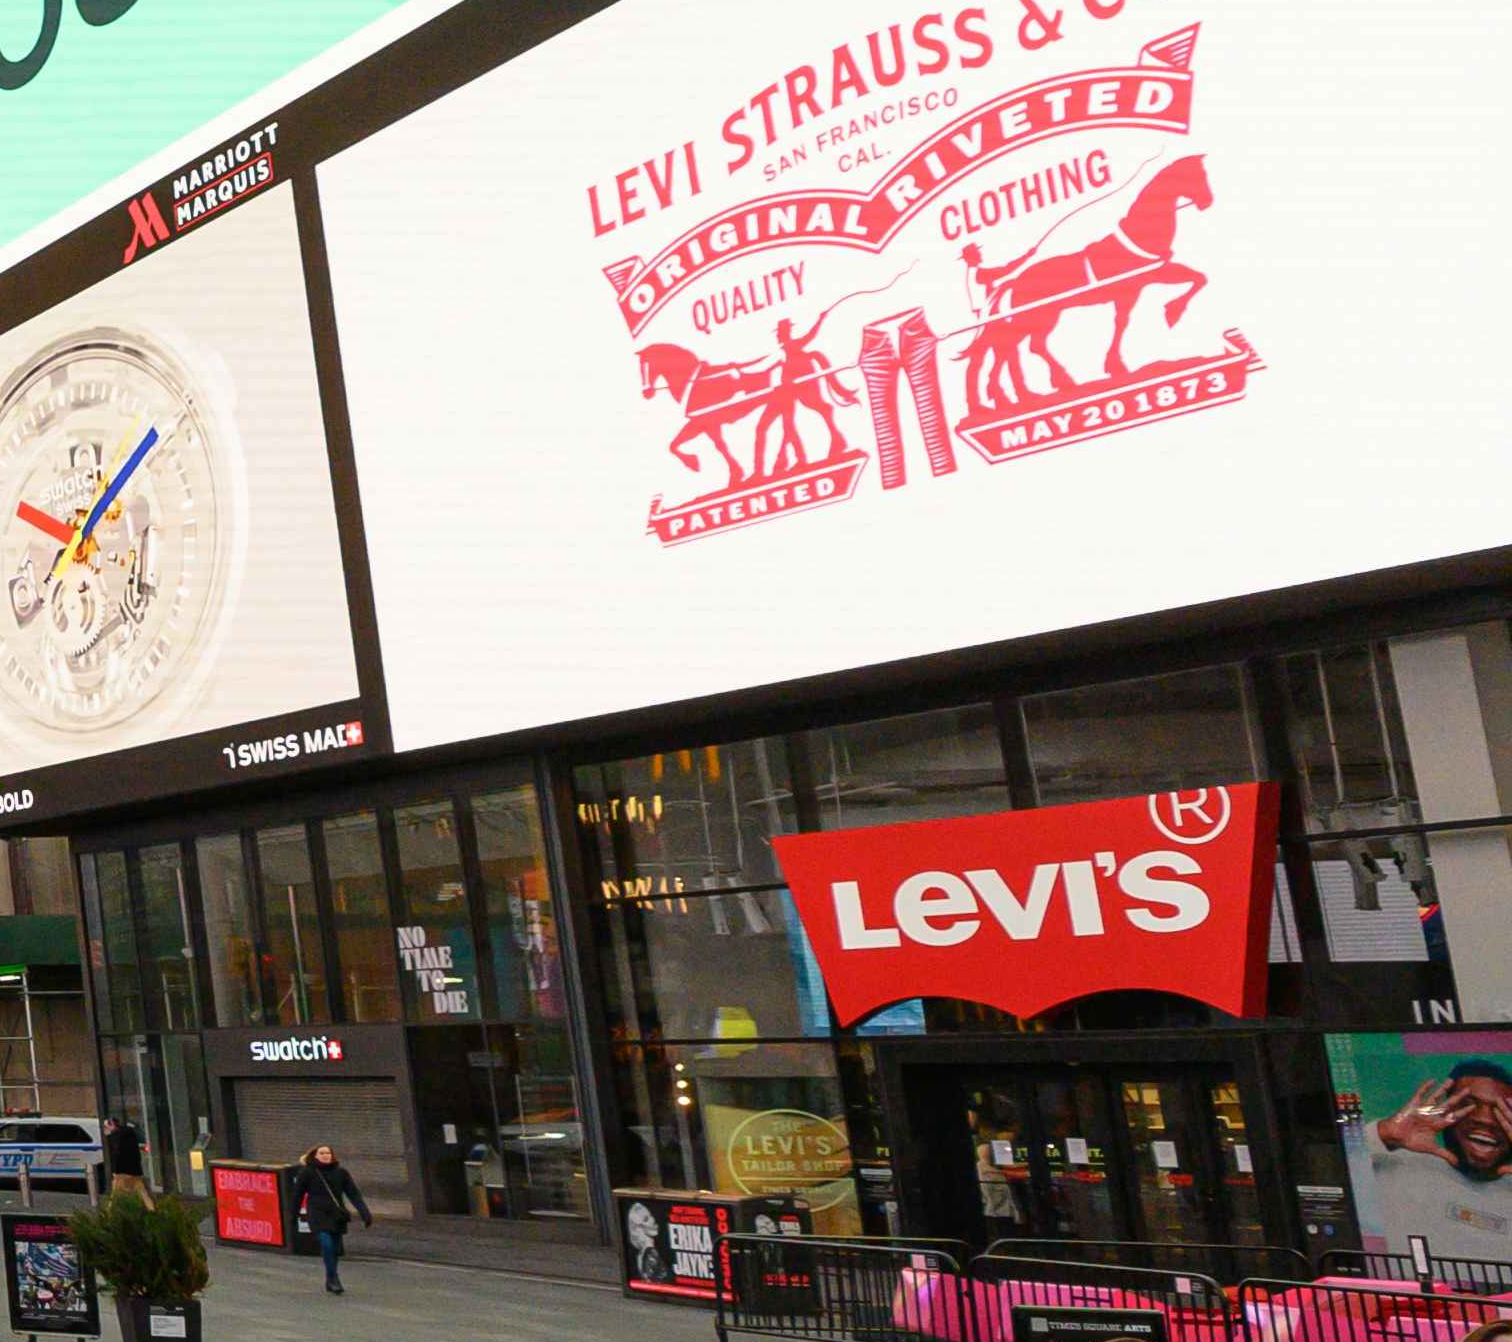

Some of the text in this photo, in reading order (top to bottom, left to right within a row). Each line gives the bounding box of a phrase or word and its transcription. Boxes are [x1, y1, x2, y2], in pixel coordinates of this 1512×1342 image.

[587, 140, 702, 239] LEVI
[722, 5, 994, 177] STRAUSS
[763, 87, 961, 185] SAN FRANCISCO
[173, 123, 279, 199] MARRIOTT
[836, 143, 892, 175] CAL.
[177, 159, 270, 226] MARQUIS
[627, 78, 1176, 317] ORIGINAL RIVETED
[690, 148, 1114, 339] QUALITY CLOTHING
[669, 368, 1229, 539] PATENTED MAY 20 1873
[238, 737, 301, 768] SWISS
[397, 927, 426, 947] NO
[400, 946, 453, 971] TIME
[416, 971, 446, 992] TO
[434, 991, 469, 1014] DIE
[1412, 999, 1458, 1024] IN
[250, 1035, 326, 1062] swatch
[744, 1135, 834, 1156] LEVI'S
[742, 1159, 795, 1172] TAILOR
[668, 1223, 713, 1252] ERIKA
[1124, 1323, 1152, 1333] ARTS
